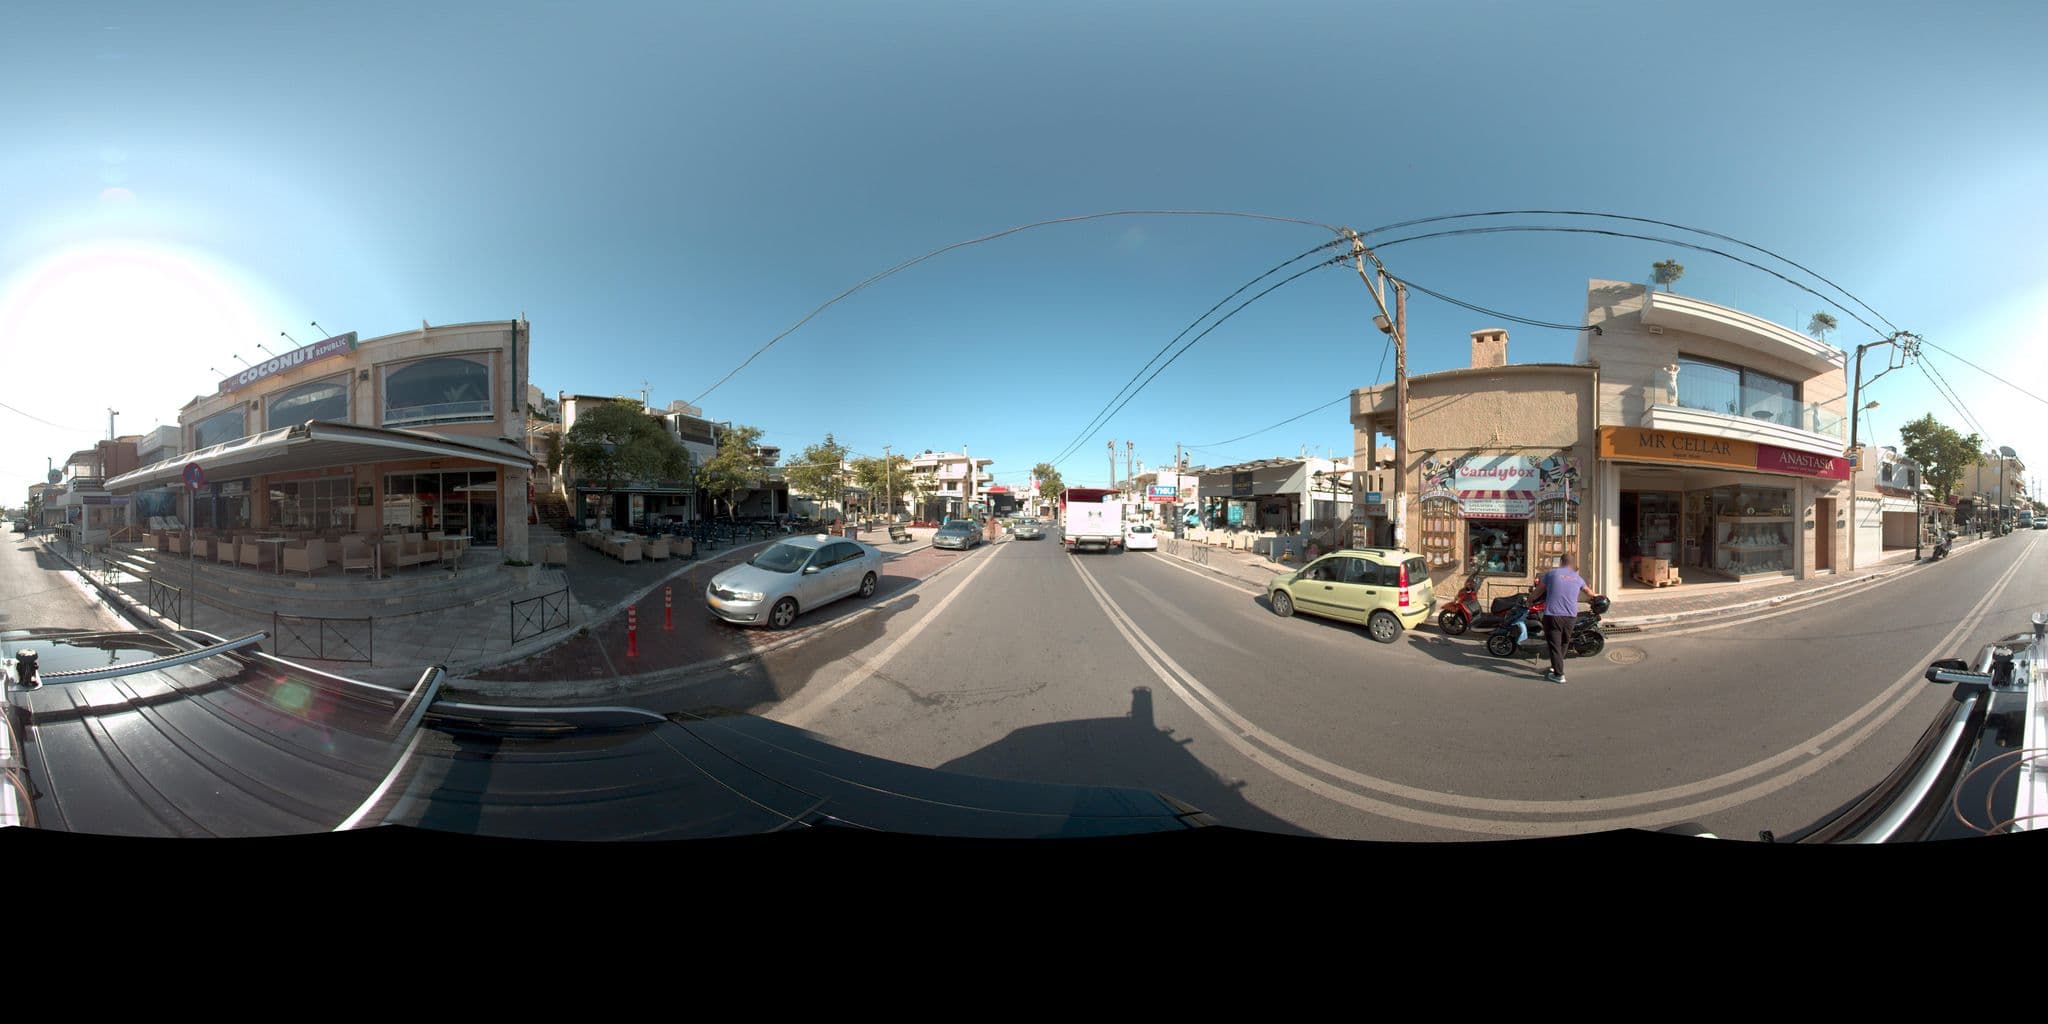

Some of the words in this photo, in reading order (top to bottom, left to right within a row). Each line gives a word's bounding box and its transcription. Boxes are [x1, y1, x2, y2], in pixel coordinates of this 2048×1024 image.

[240, 345, 315, 384] COCONUT
[315, 338, 346, 356] REPUBLIC
[1640, 432, 1666, 448] MR
[1672, 436, 1732, 456] CELLAR
[1780, 451, 1834, 471] ANASTASIA
[1460, 465, 1535, 481] Candybox
